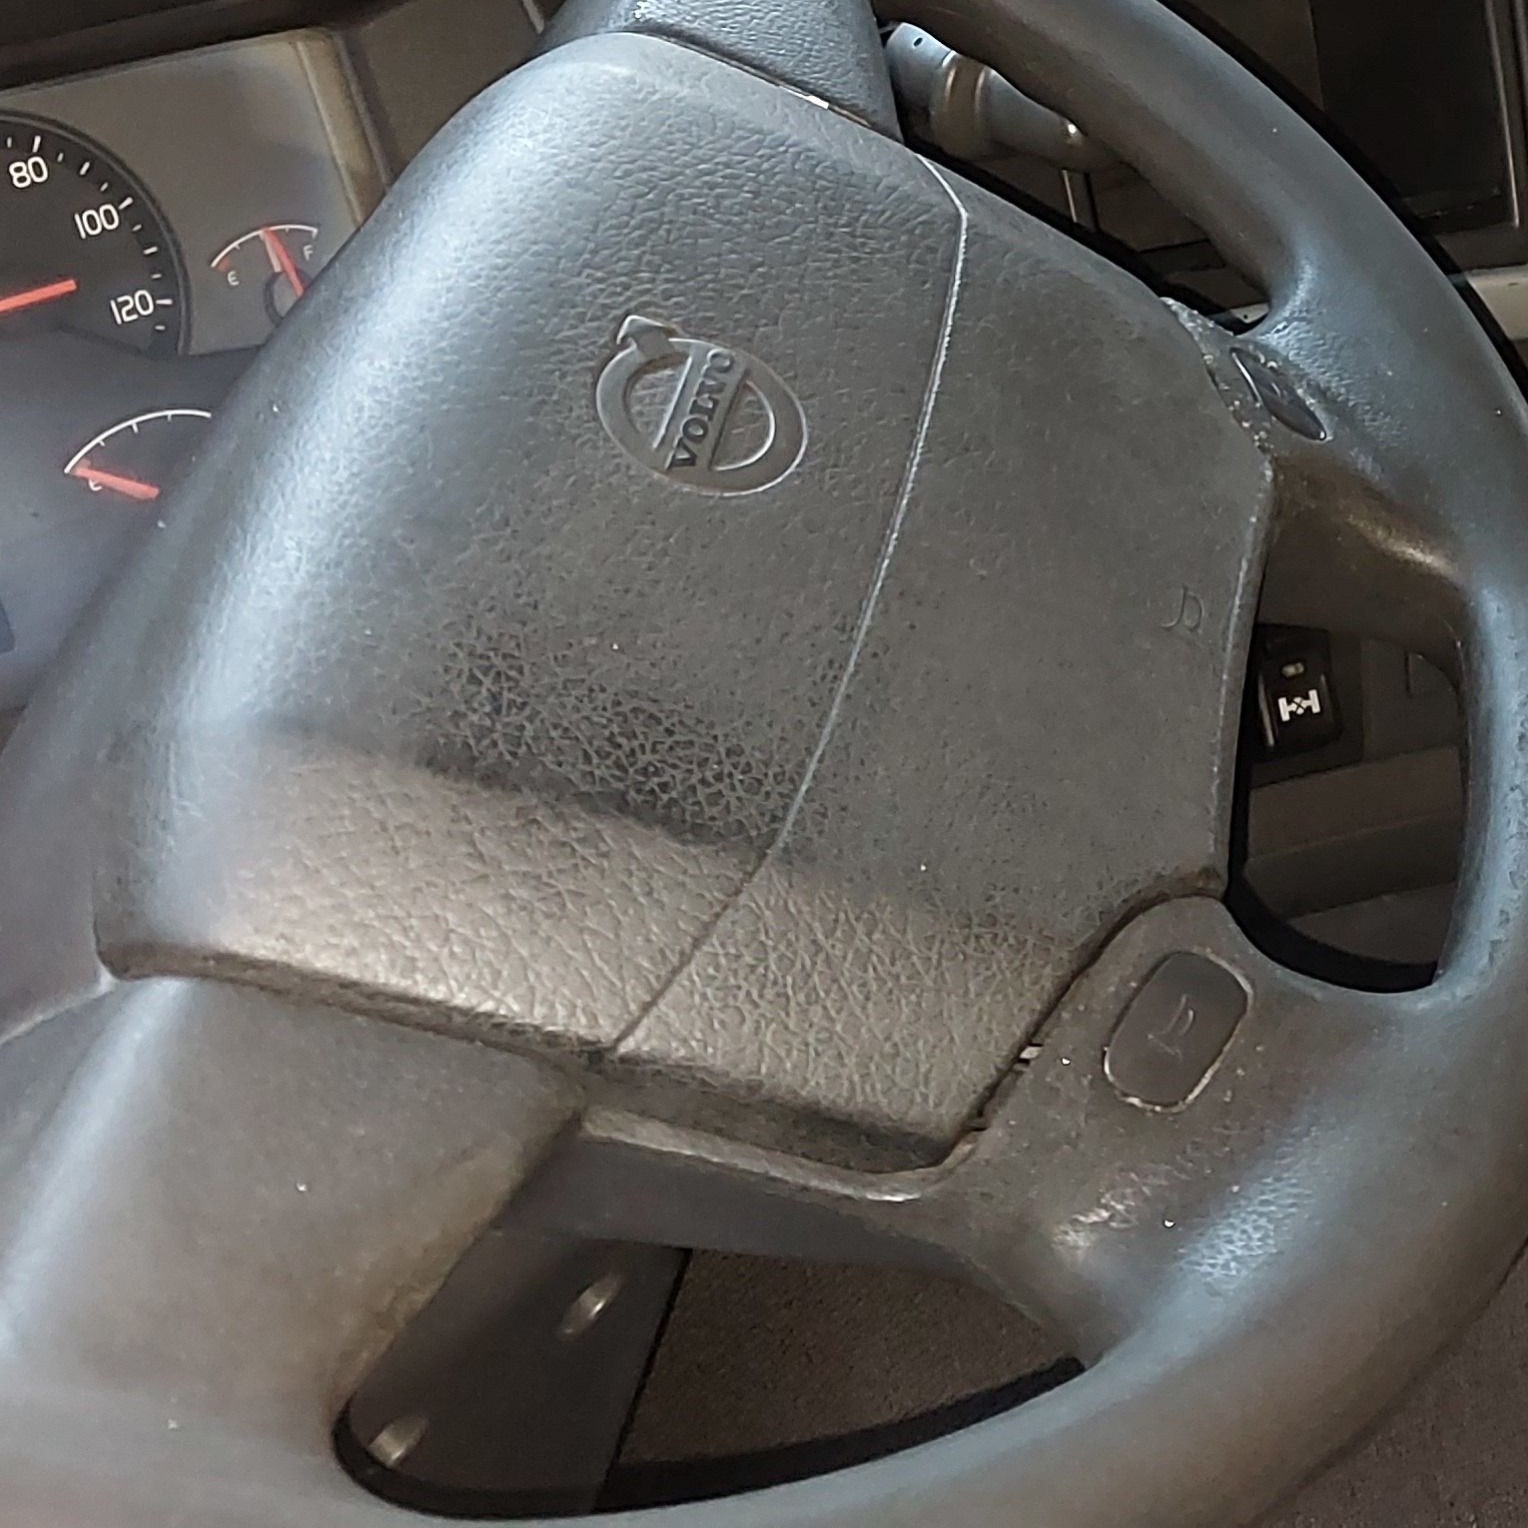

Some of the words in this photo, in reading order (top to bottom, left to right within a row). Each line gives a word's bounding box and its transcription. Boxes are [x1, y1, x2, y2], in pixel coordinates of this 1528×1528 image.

[9, 156, 48, 188] 80
[74, 203, 120, 239] 100
[303, 244, 313, 261] F
[227, 270, 239, 286] E
[110, 289, 155, 325] 120
[664, 347, 736, 471] VOLVO
